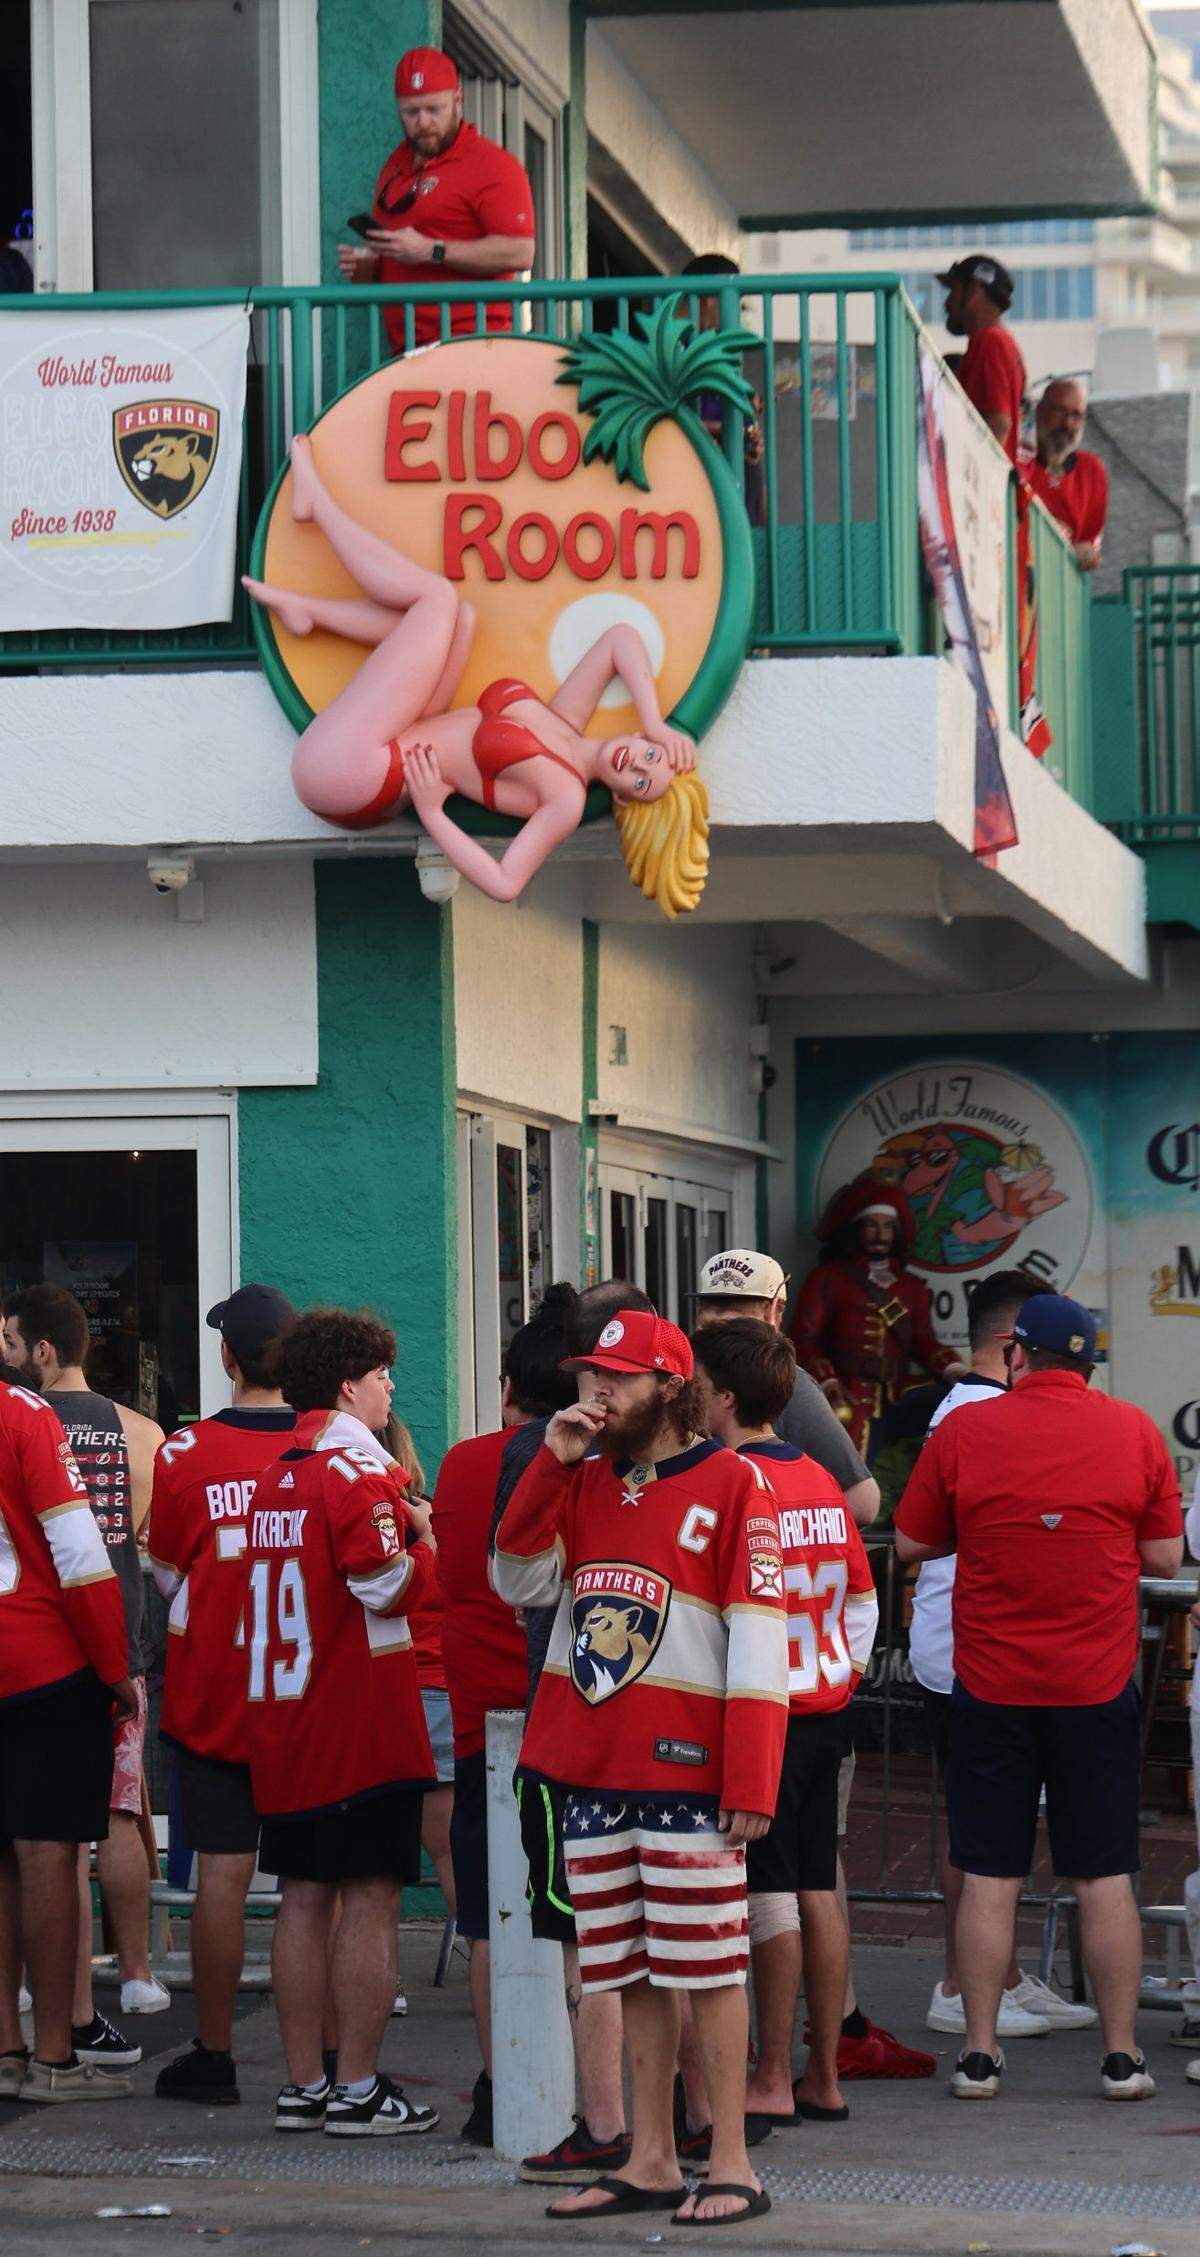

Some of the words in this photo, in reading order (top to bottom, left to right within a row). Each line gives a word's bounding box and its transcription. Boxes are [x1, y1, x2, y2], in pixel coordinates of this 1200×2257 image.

[38, 356, 96, 387] World
[100, 355, 174, 388] Famous
[124, 406, 208, 430] FLORIDA
[384, 390, 582, 482] Elbo
[11, 509, 68, 541] Since
[72, 509, 117, 534] 1938
[443, 493, 700, 581] Room
[862, 1077, 941, 1136] World
[942, 1075, 1033, 1138] Famous
[708, 1258, 755, 1278] PANTHERS
[66, 1431, 127, 1447] THERS
[115, 1471, 124, 1485] 2
[326, 1448, 391, 1485] 19
[115, 1492, 124, 1506] 2
[114, 1513, 123, 1527] 3
[677, 1503, 718, 1554] C
[106, 1533, 127, 1544] CUP
[574, 1571, 657, 1602] PANTHERS
[247, 1557, 314, 1702] 19
[783, 1560, 852, 1694] 63
